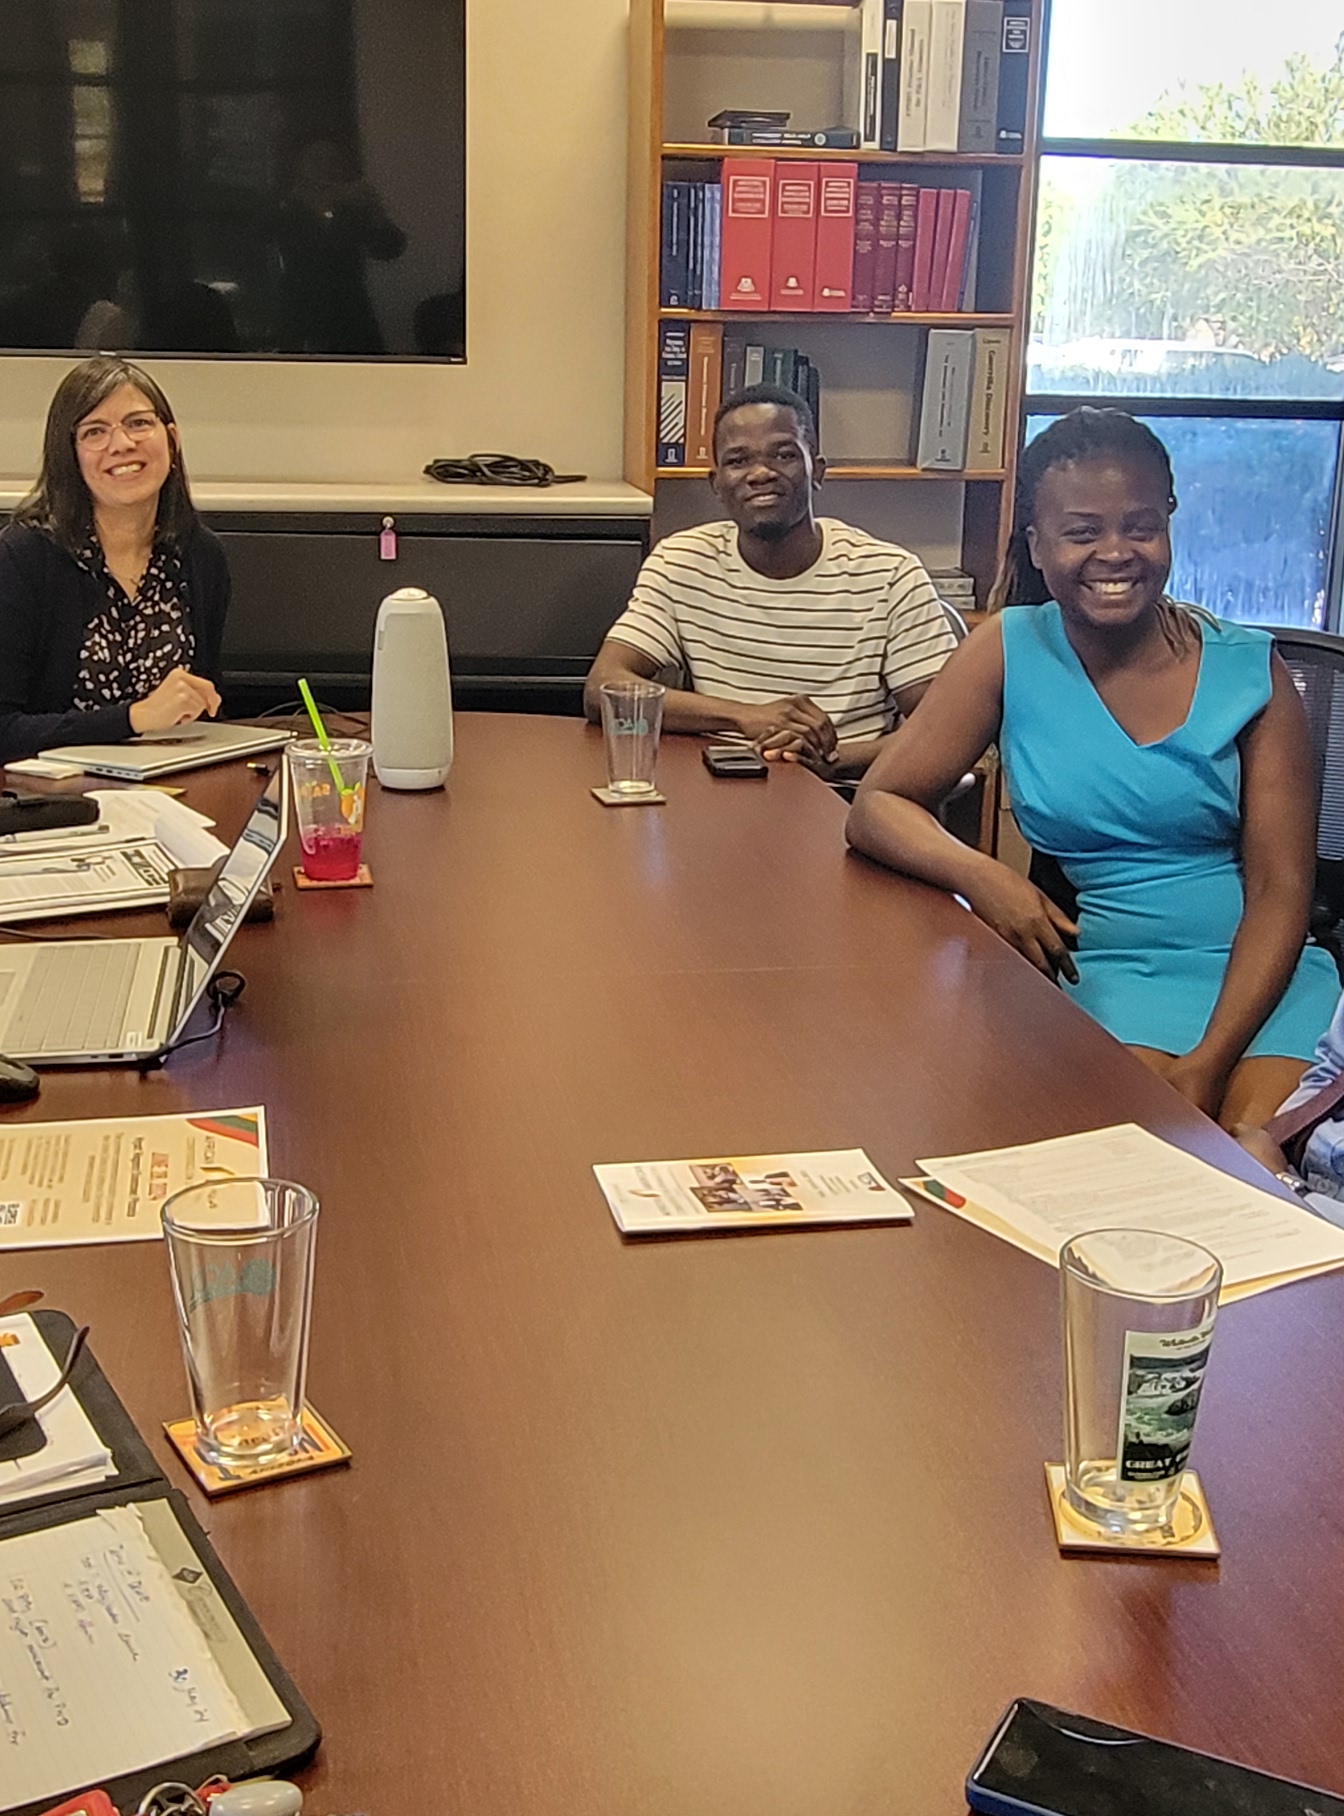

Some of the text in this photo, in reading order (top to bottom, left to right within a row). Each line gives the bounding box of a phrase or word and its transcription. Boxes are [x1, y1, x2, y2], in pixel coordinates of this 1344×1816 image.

[987, 349, 997, 390] Guerrilla
[982, 393, 993, 437] Discovery
[1126, 1457, 1172, 1469] GREAT
